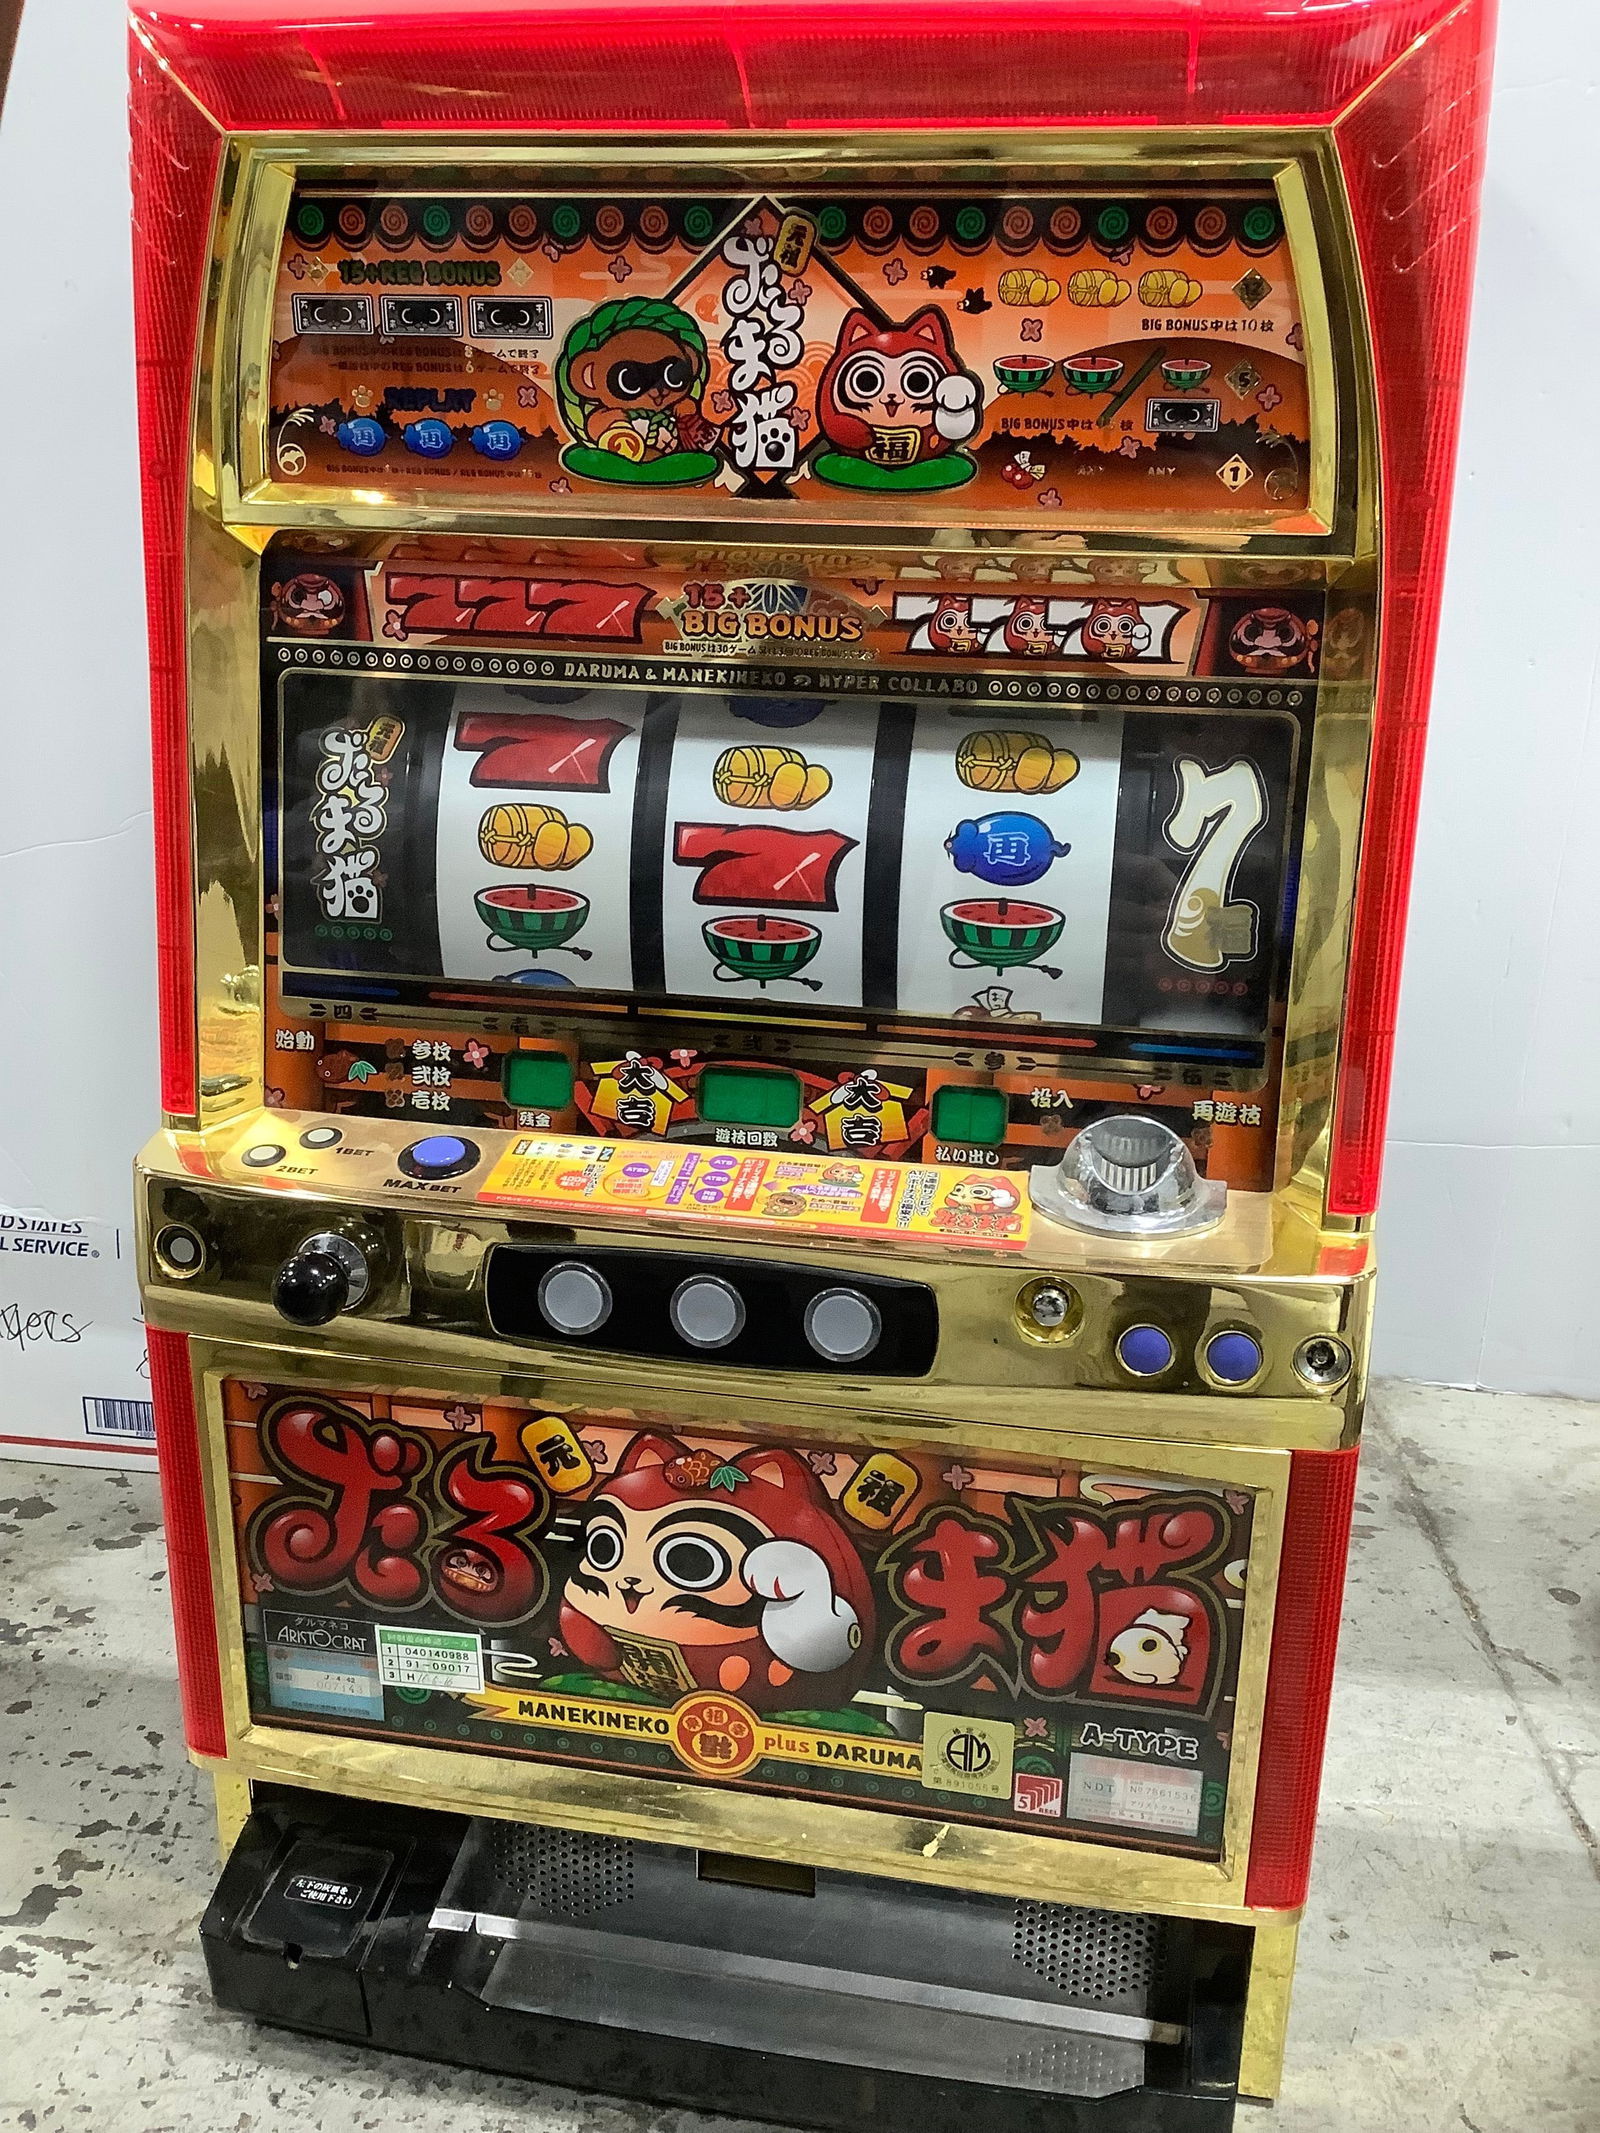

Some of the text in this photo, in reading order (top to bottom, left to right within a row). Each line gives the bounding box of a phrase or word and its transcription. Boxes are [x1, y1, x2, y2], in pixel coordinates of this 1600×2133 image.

[1141, 319, 1162, 331] BIG
[1001, 418, 1021, 430] BIG
[1148, 466, 1176, 476] ANY
[683, 610, 864, 642] BIG BONUS
[564, 662, 639, 680] DARUMA
[645, 668, 658, 681] &
[662, 667, 787, 687] MANEKINEKO
[819, 674, 880, 690] HYPER
[888, 676, 978, 695] COLLABO
[275, 1028, 315, 1051] 始動
[411, 1039, 452, 1061] 参枚
[411, 1090, 451, 1111] 壱枚
[616, 1059, 656, 1126] 大吉
[1031, 1087, 1074, 1109] 投入
[519, 1111, 551, 1128] 残金
[841, 1076, 883, 1146] 大吉
[1192, 1100, 1262, 1126] 再遊技
[715, 1127, 779, 1147] 遊技回数
[335, 1147, 374, 1157] 1BET
[935, 1145, 1000, 1166] 払い出し
[275, 1165, 319, 1176] 2BET
[383, 1178, 462, 1194] MAX BET
[295, 1616, 349, 1631] ダルマネコ
[277, 1626, 367, 1651] ARISTOCRAT
[405, 1648, 470, 1661] 040140988
[406, 1660, 471, 1674] 91-09017
[518, 1700, 670, 1735] MANEKINEKO
[1080, 1722, 1199, 1760] A-TYPE
[764, 1734, 810, 1753] plus
[816, 1741, 923, 1771] DARUMA
[1083, 1781, 1114, 1793] NDT
[1018, 1796, 1028, 1809] 5
